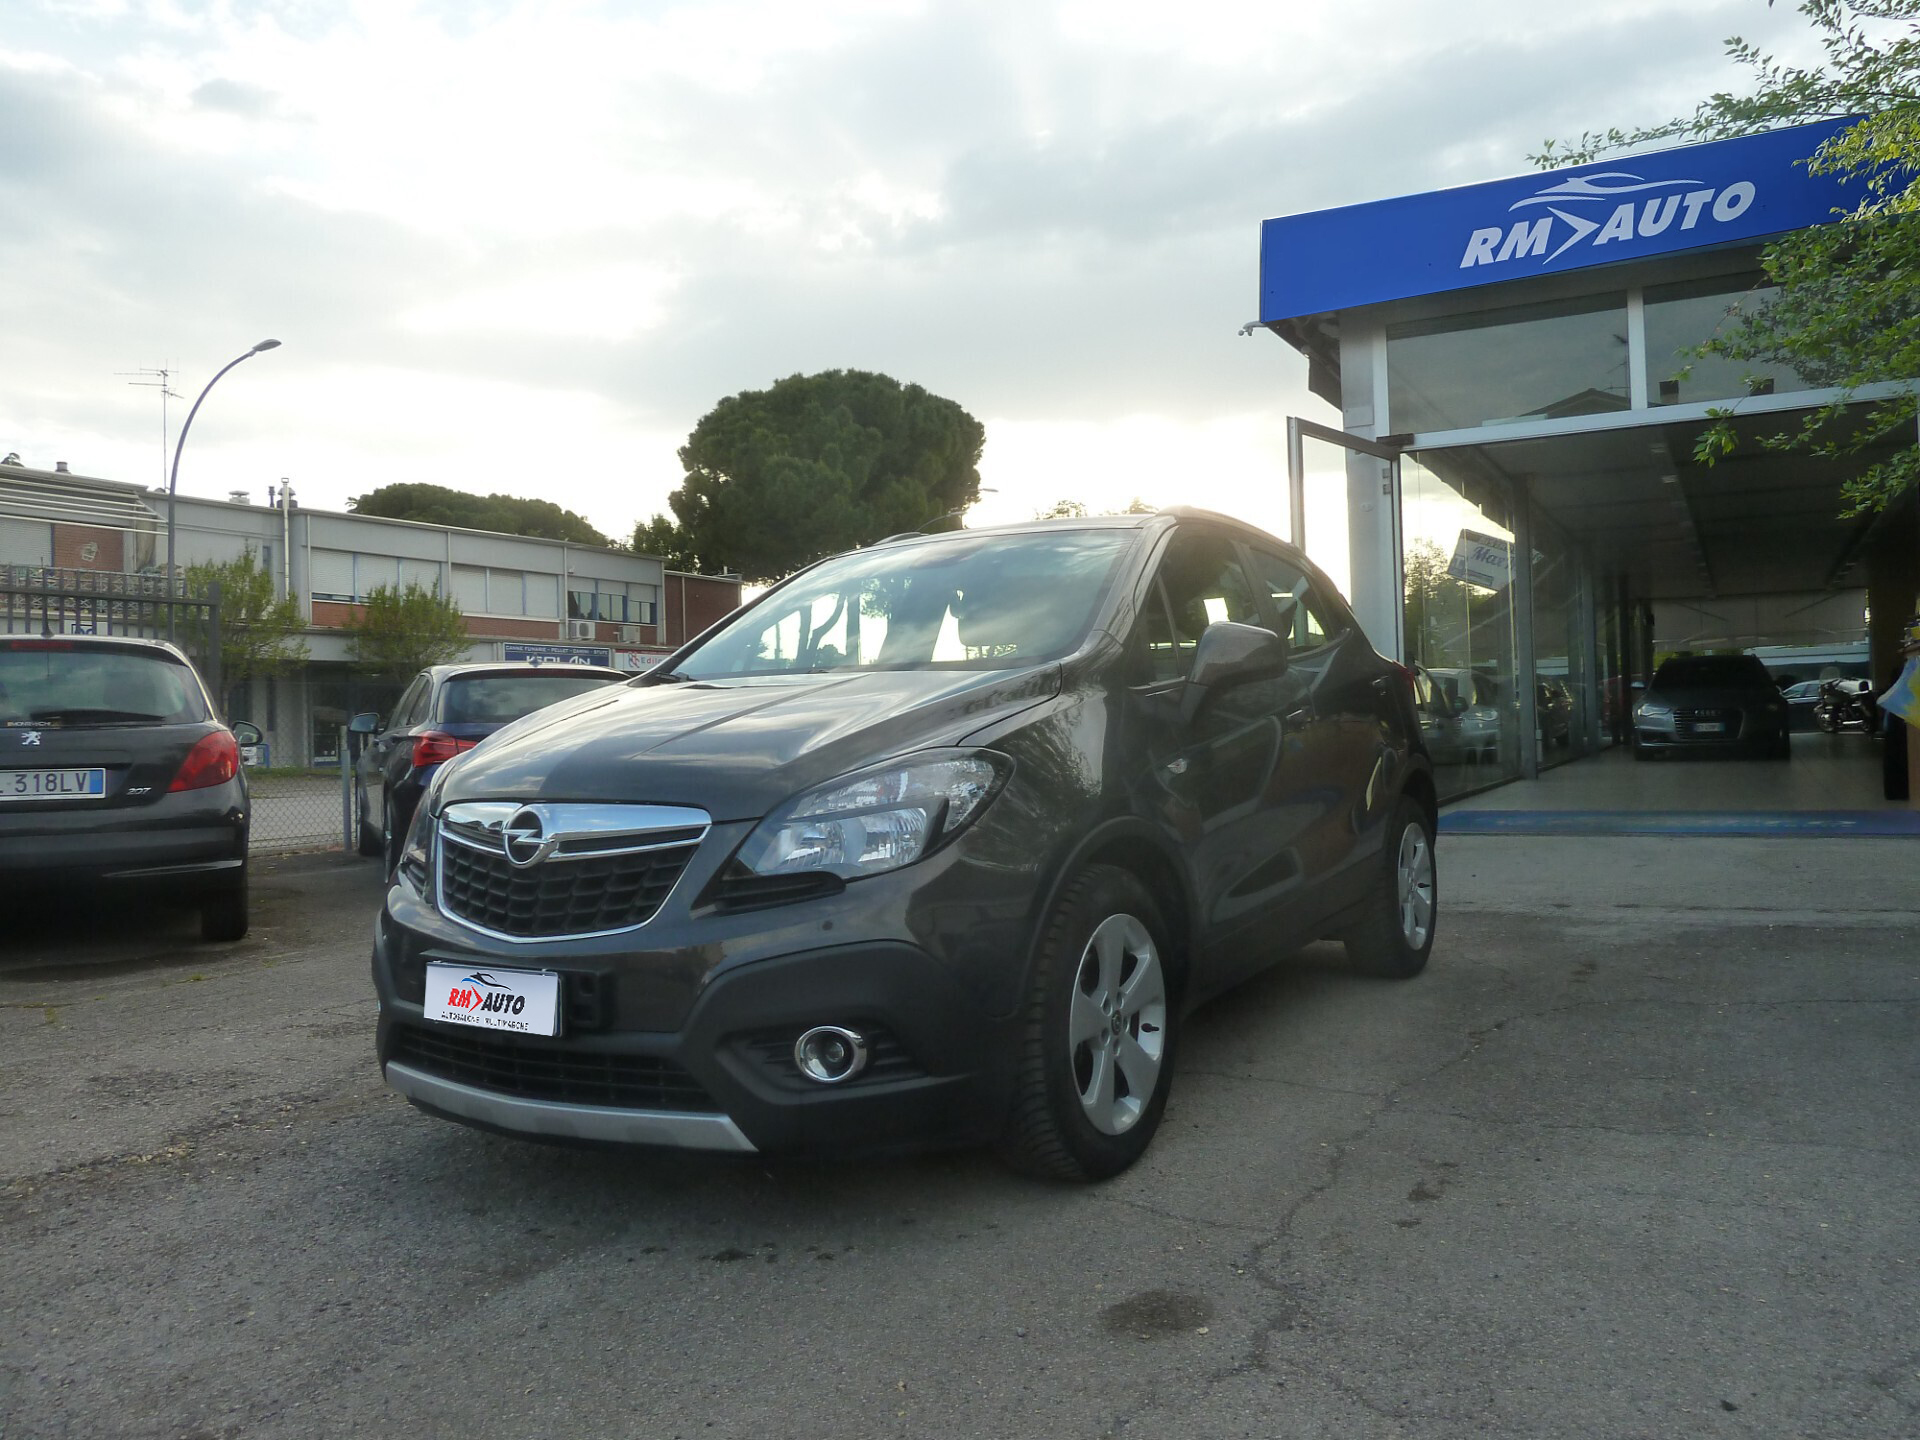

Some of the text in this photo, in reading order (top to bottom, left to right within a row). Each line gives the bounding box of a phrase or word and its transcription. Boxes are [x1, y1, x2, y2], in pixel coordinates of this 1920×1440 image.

[1460, 181, 1756, 269] RM AUTO
[15, 772, 87, 793] 318LV
[127, 787, 151, 795] 207
[447, 988, 526, 1015] RM AUTO
